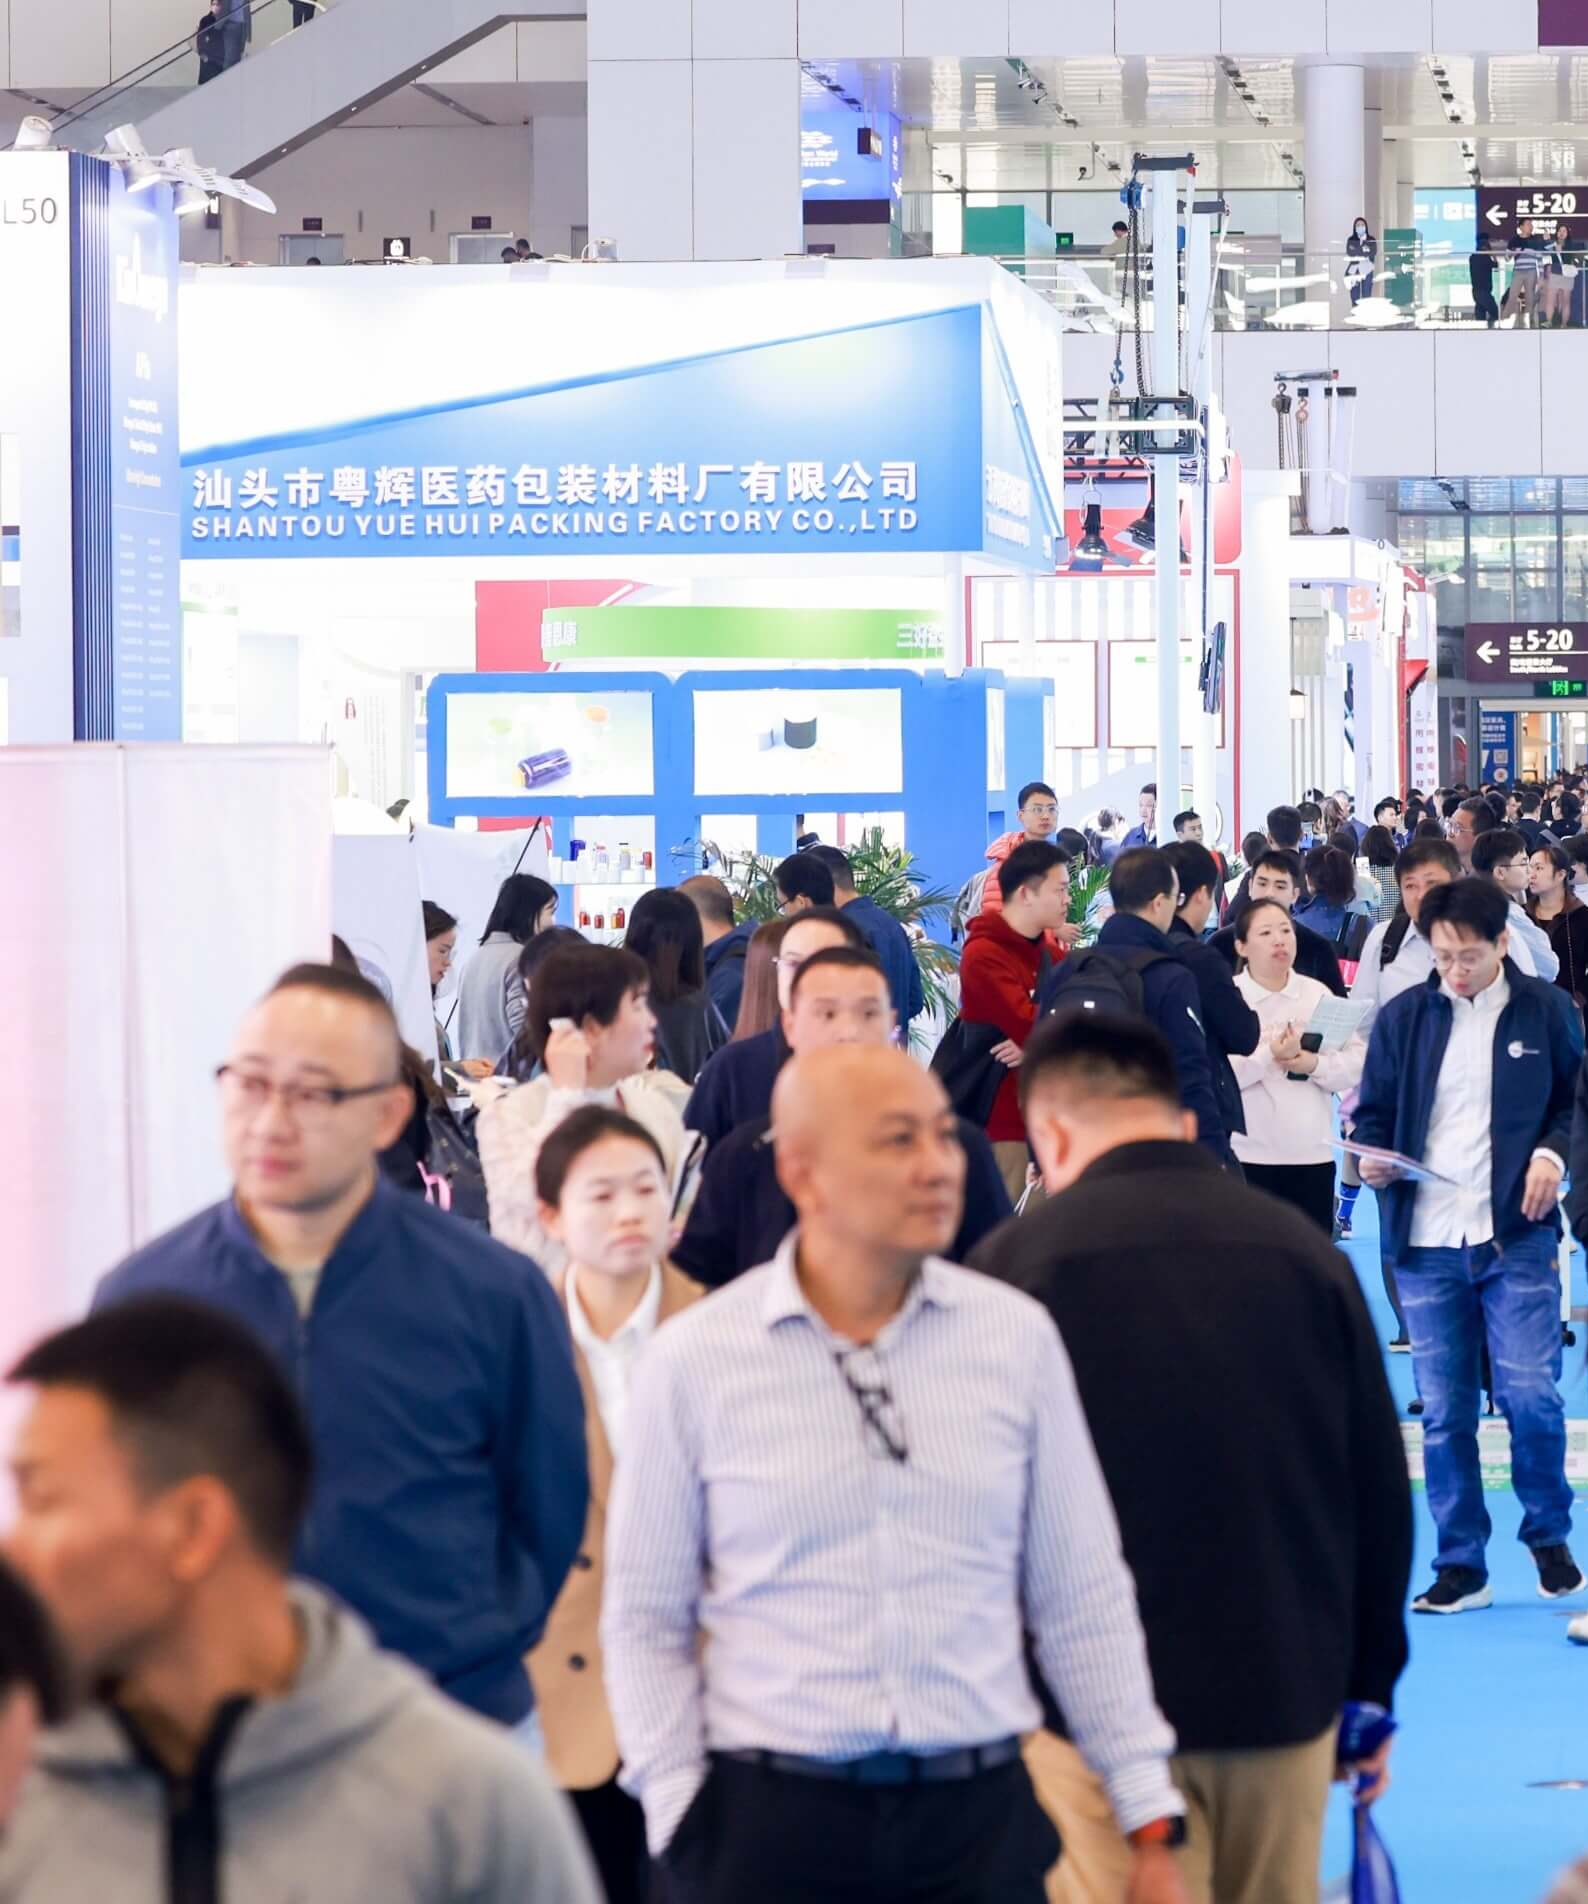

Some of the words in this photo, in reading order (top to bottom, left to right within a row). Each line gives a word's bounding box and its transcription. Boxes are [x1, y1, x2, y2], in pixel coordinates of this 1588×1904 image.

[3, 197, 59, 224] L50
[1531, 191, 1577, 215] 5-20
[192, 461, 918, 511] 汕头市粤辉医药包装材料厂有限公司
[191, 515, 346, 539] SHANTOU
[353, 513, 417, 536] YUE
[425, 512, 480, 536] HUI
[488, 511, 628, 535] PACKING
[638, 509, 783, 534] FACTORY
[791, 508, 918, 534] CO.,LTD
[1526, 628, 1574, 651] 5-20
